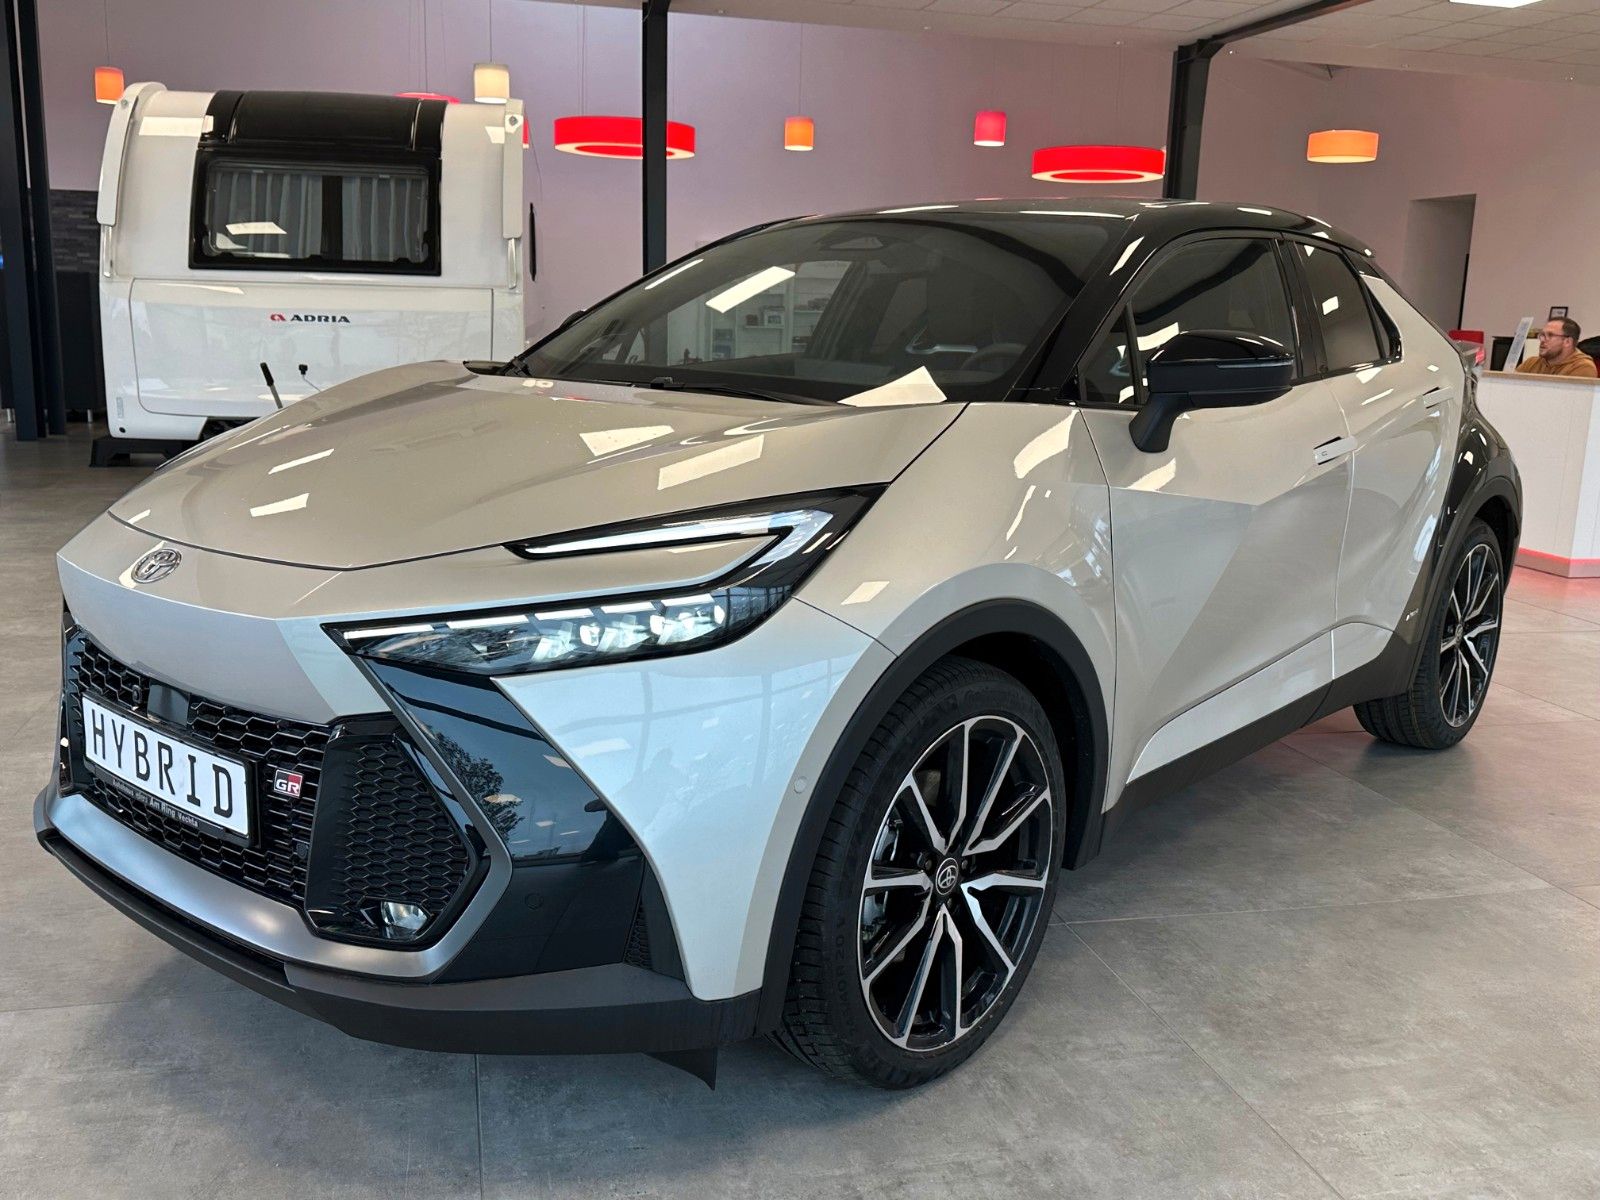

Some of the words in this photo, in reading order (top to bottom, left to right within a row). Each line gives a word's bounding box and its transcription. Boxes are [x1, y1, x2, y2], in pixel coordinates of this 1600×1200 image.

[290, 314, 350, 323] ADRIA
[91, 709, 233, 818] HYBRID
[275, 778, 299, 794] GR
[149, 796, 160, 809] Am
[161, 801, 176, 818] Ring
